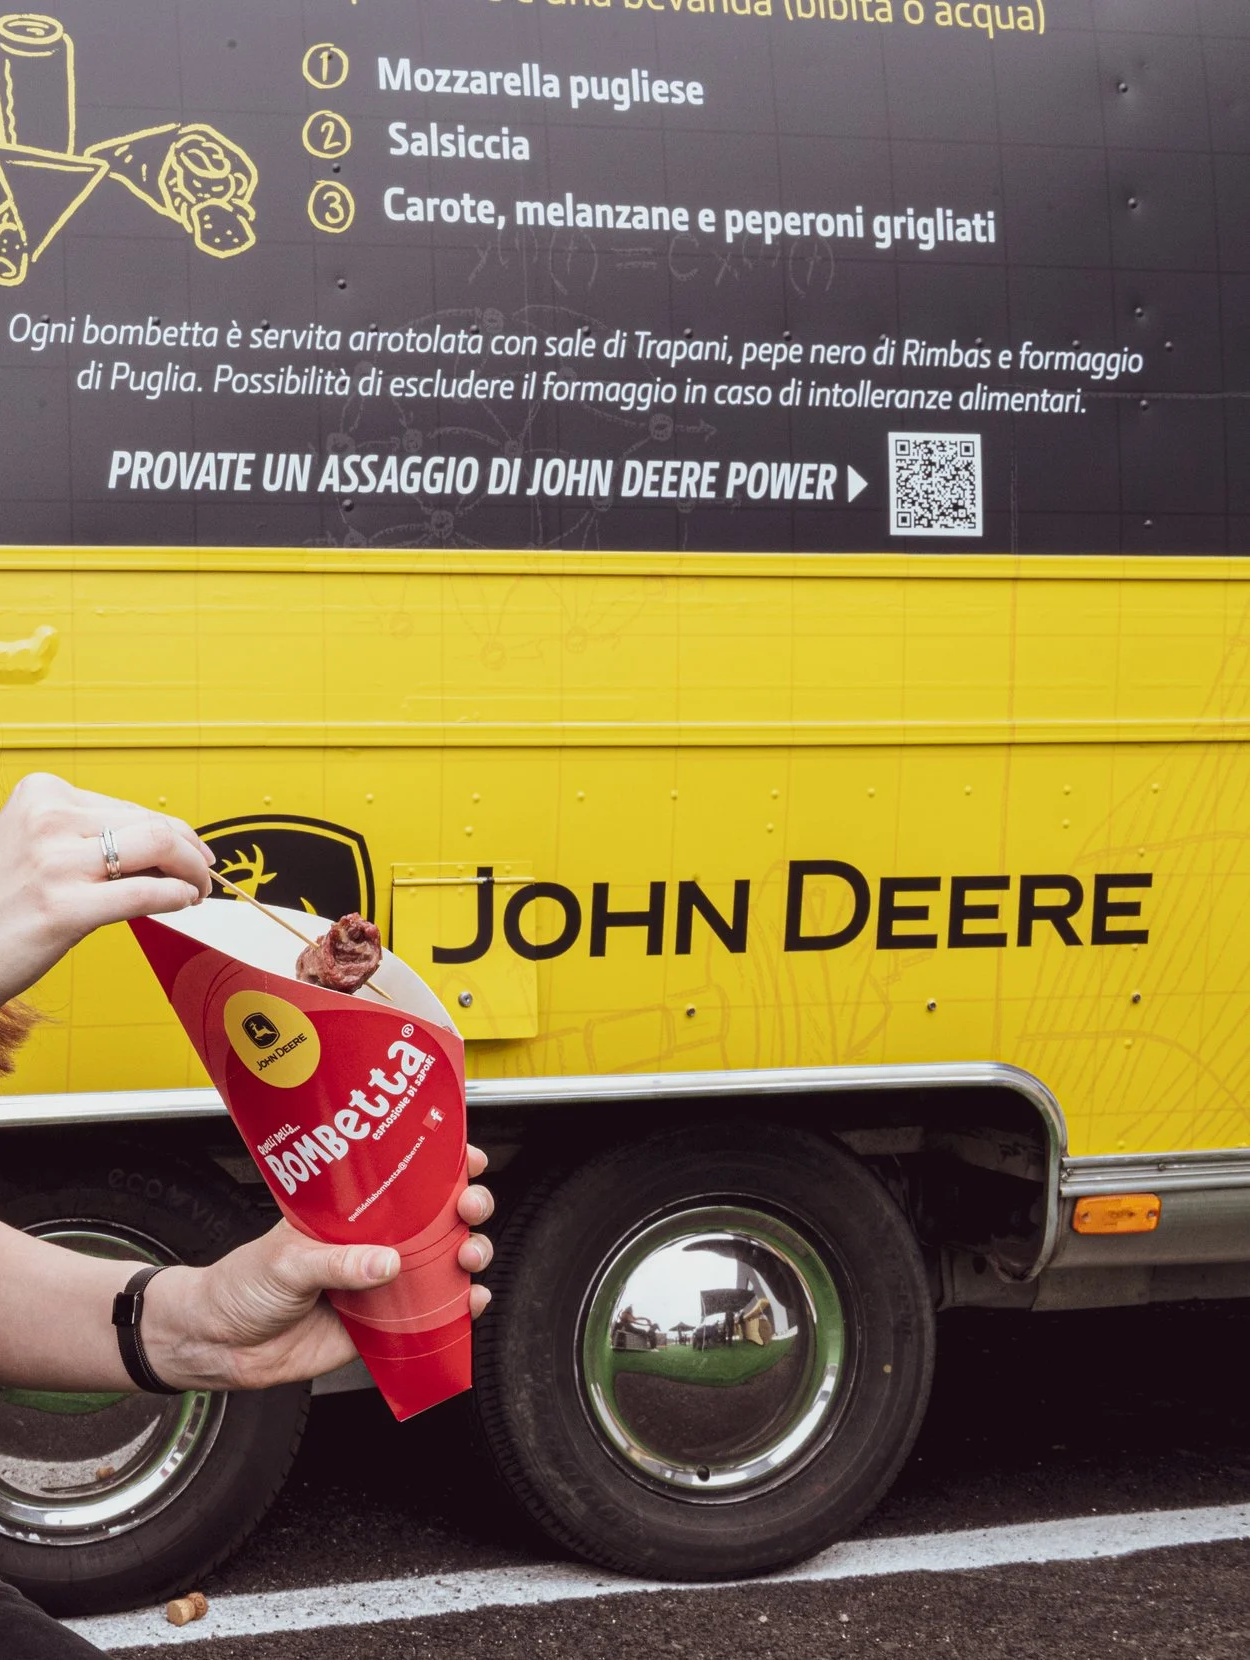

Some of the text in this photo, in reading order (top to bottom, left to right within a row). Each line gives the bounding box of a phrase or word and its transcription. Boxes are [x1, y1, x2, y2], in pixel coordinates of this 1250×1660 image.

[903, 0, 925, 25] o
[935, 0, 1045, 39] acqua)
[377, 56, 561, 99] Mozzarella
[569, 67, 704, 112] pugliese
[388, 121, 530, 161] Salsiccia
[383, 186, 506, 230] Carote,
[515, 192, 690, 232] melanzane
[697, 208, 716, 233] e
[724, 205, 864, 245] peperoni
[872, 207, 996, 251] grigliati
[8, 313, 1143, 380] Ogni bombetta è servita arrotolata con sale di Trapani, pepe nero di Rimbas e formaggio
[76, 360, 1086, 414] di Puglia. Possibilità di escludere il formaggio in caso di intolleranze alimentari.
[107, 450, 837, 500] PROVATE UN ASSAGGIO DI JOHN DEERE POWER
[432, 859, 1153, 964] JOHN DEERE
[256, 1033, 308, 1071] JOHN DEERE
[348, 1135, 426, 1222] quellidellabombetta@libero.it
